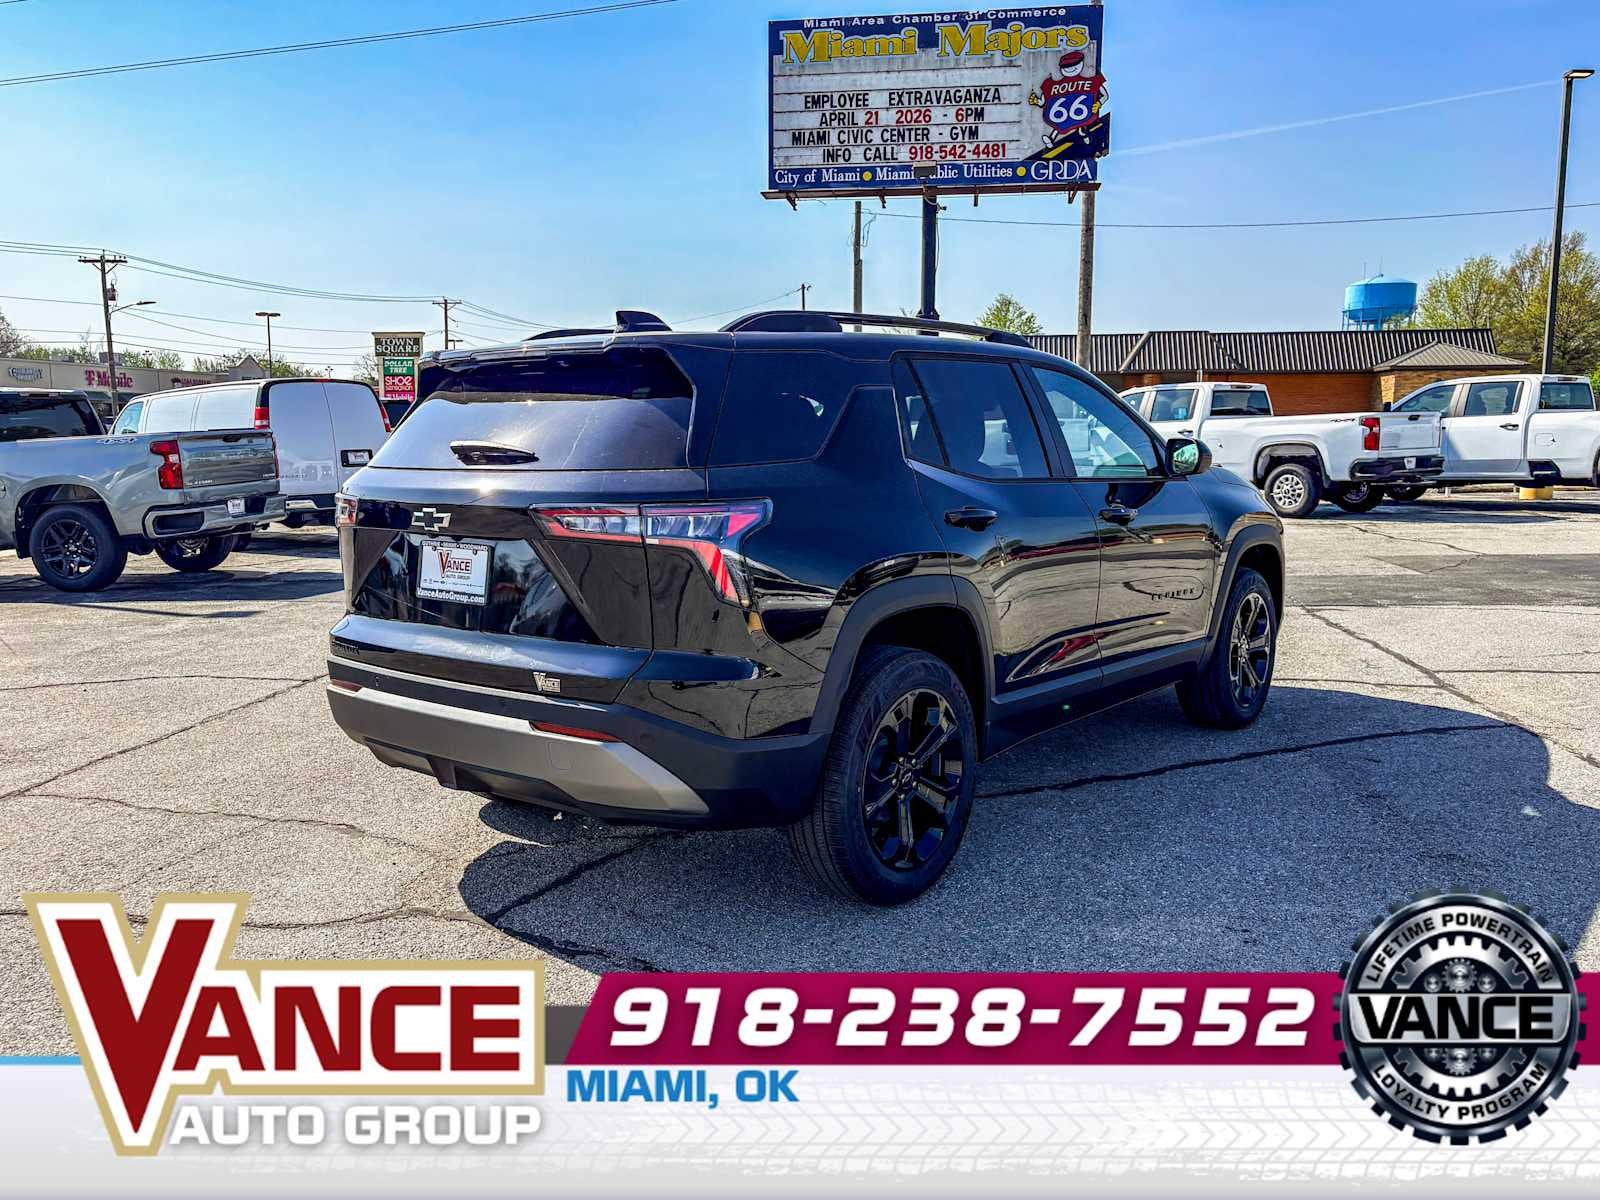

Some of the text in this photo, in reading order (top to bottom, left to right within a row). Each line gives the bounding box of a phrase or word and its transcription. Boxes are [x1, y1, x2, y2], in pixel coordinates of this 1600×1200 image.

[803, 19, 846, 28] Miami
[851, 16, 885, 26] Area
[892, 13, 958, 24] Chamber
[987, 8, 1066, 20] Commerce
[782, 23, 1088, 64] Miami Majors
[1050, 81, 1093, 95] ROUTE
[804, 87, 1002, 110] EMPLOYEE EXTRAVAGANZA
[819, 112, 858, 127] APRIL
[864, 110, 879, 126] 21
[895, 108, 932, 125] 2026
[955, 107, 985, 123] 6PM
[1049, 95, 1089, 123] 66
[791, 130, 831, 146] MIAMI
[837, 128, 874, 145] CIVIC
[880, 127, 930, 143] CENTER
[949, 125, 979, 141] GYM
[822, 143, 1007, 163] INFO CALL 918-542-4481
[774, 168, 861, 188] City of Miami
[875, 165, 915, 182] Miami
[963, 162, 1013, 178] Utilities
[1030, 160, 1092, 180] GRDA
[376, 345, 420, 353] SQUARE
[380, 338, 415, 346] TOWN
[437, 549, 472, 578] VANCE
